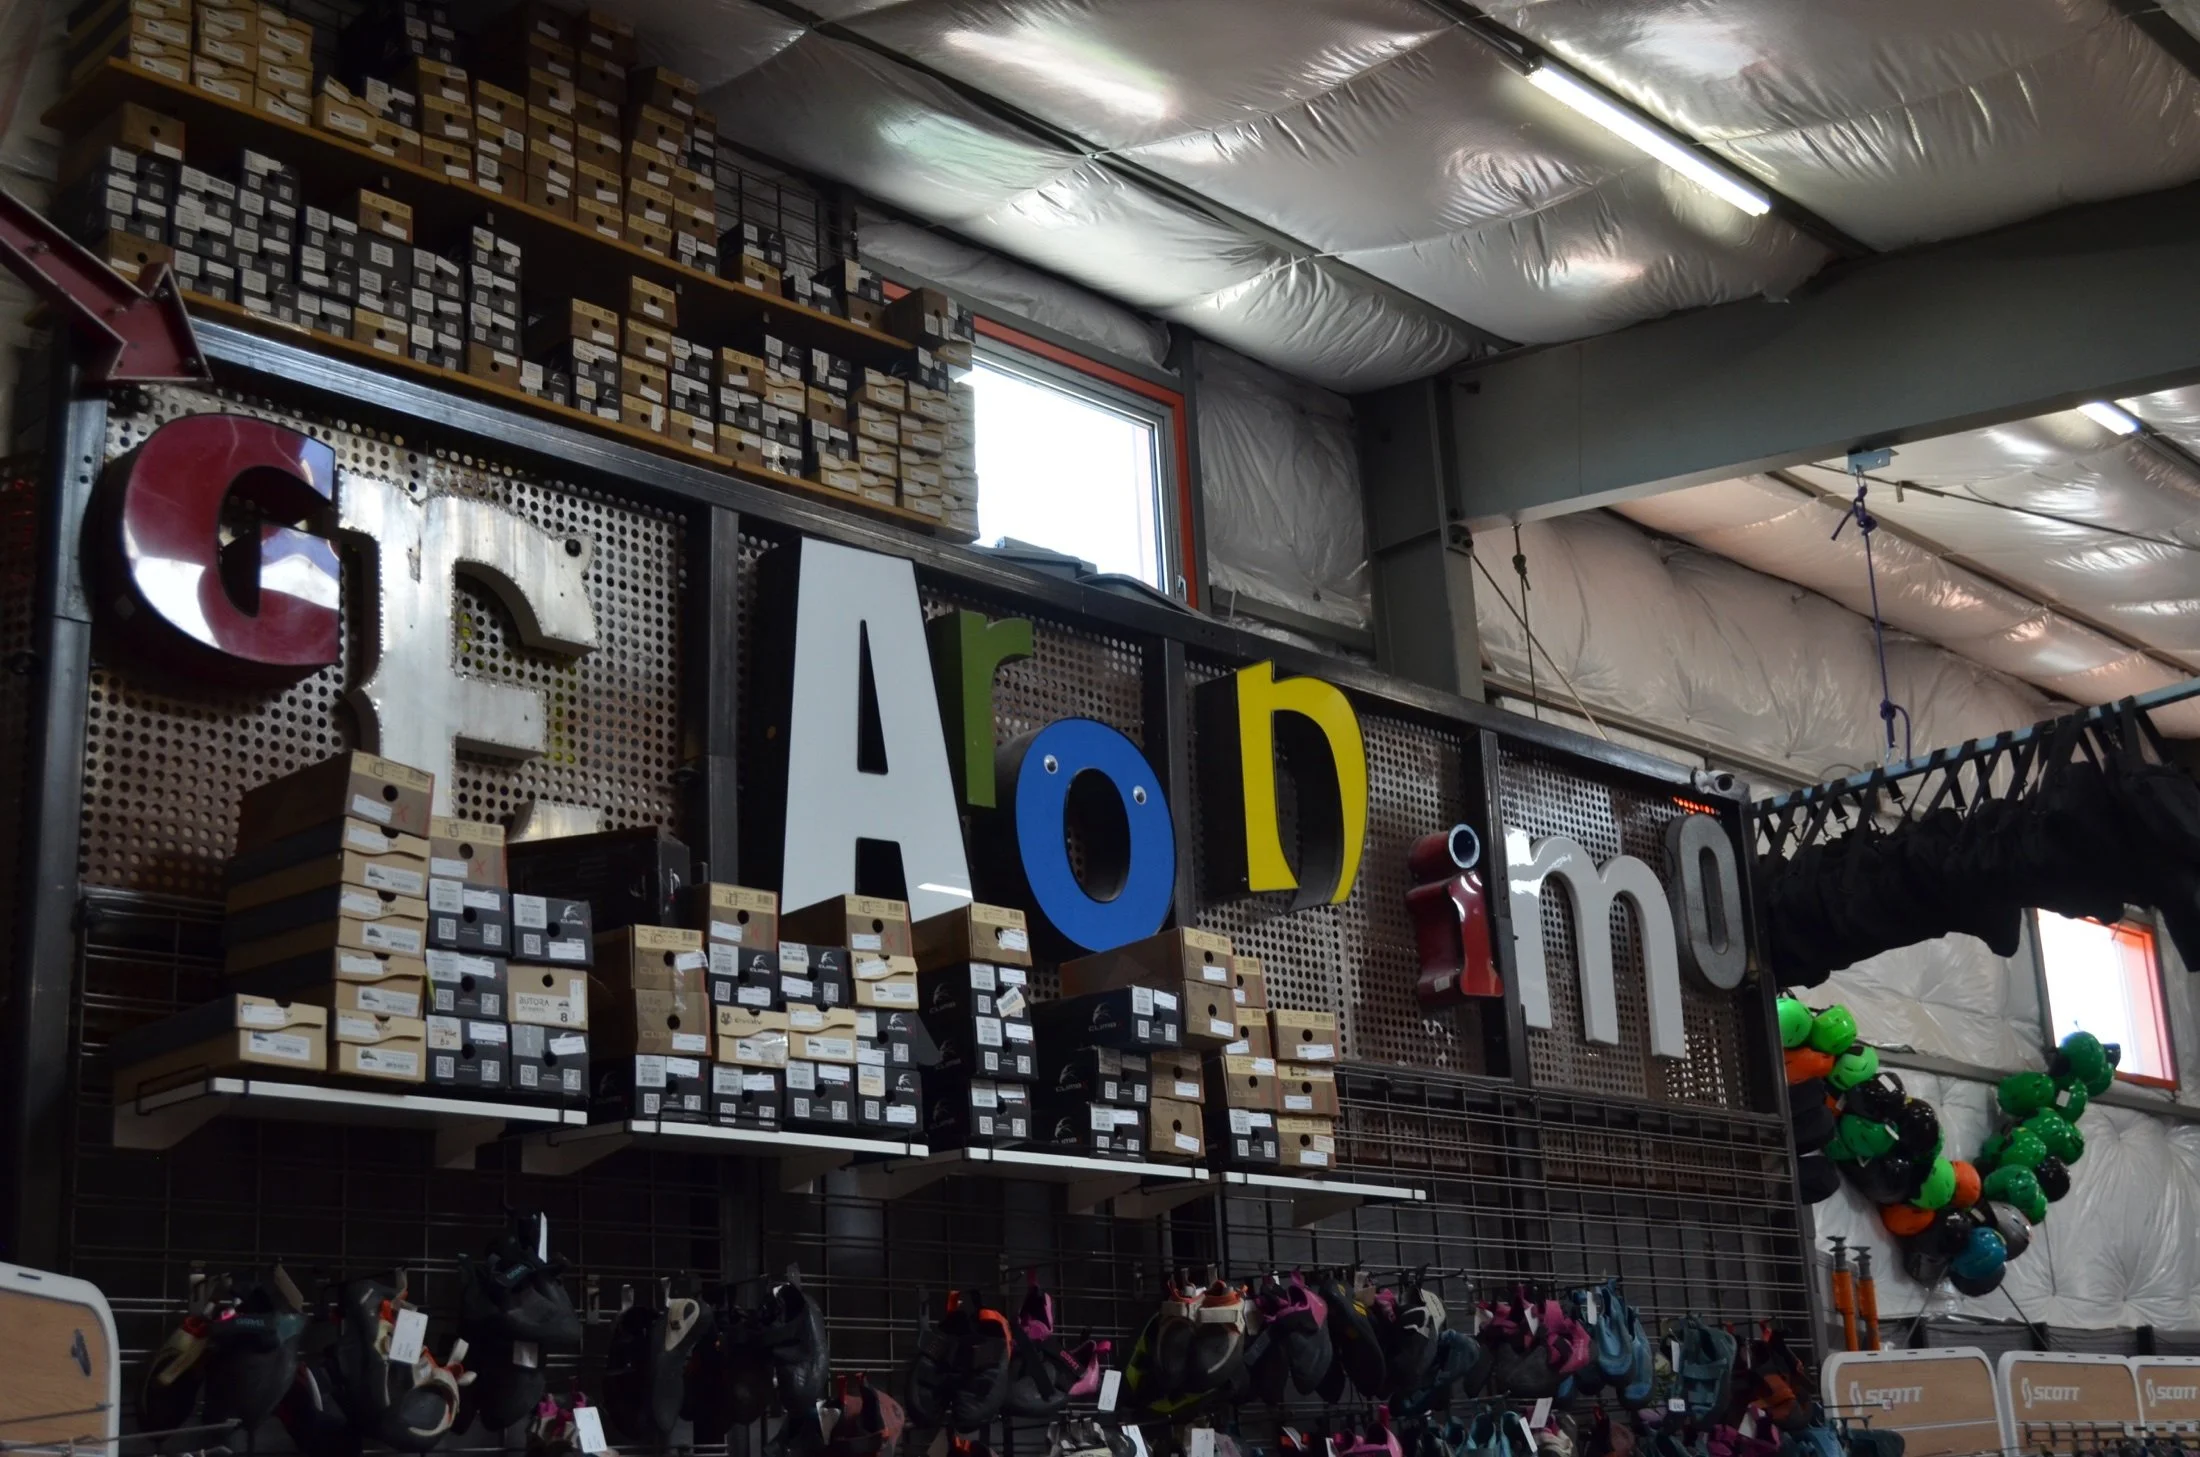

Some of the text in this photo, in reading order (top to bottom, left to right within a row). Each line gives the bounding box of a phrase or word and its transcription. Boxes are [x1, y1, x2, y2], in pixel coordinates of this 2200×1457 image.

[560, 1012, 568, 1023] 8
[1865, 1385, 1924, 1404] SCOTT
[2033, 1386, 2080, 1401] SCOTT
[2156, 1386, 2199, 1401] SCOTT
